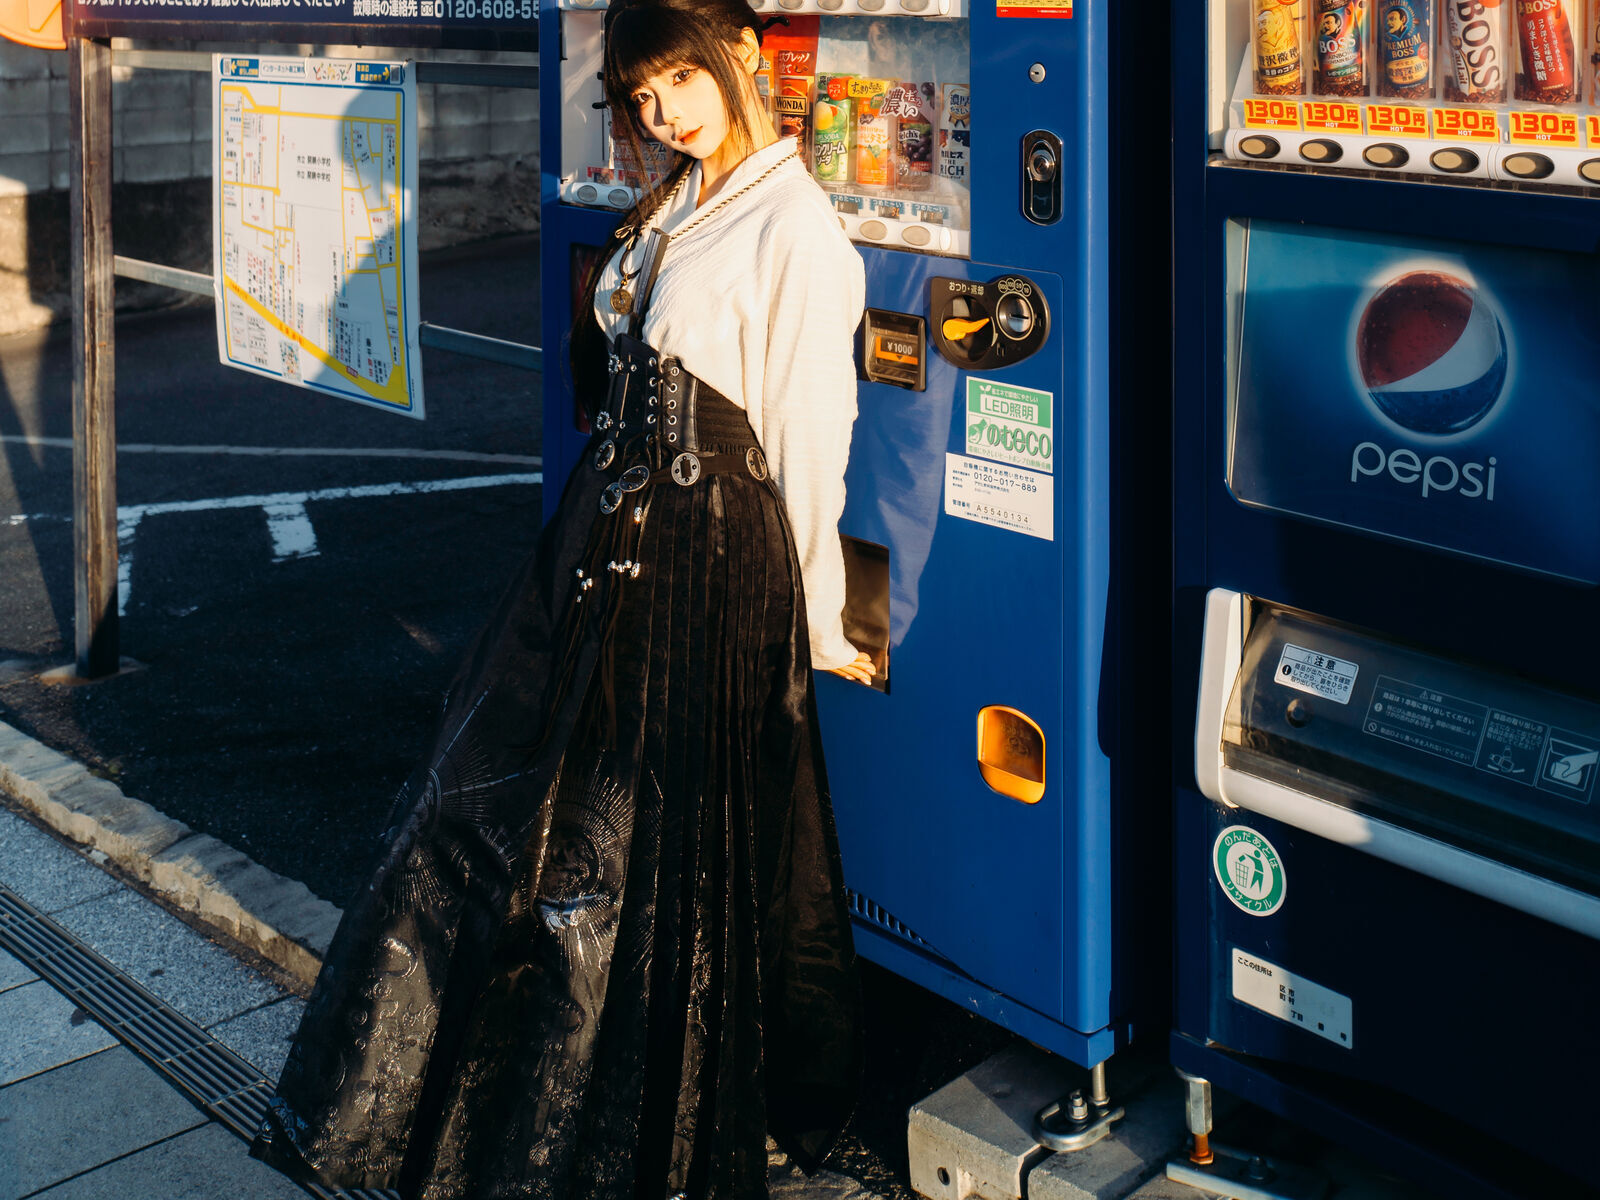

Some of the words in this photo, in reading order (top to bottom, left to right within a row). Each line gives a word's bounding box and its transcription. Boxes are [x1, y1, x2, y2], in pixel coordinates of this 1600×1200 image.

[353, 0, 418, 18] 故障時の連絡先
[434, 0, 540, 19] 0120-608-55
[1320, 33, 1356, 53] BOSS
[1391, 47, 1415, 59] BOSS
[1456, 0, 1500, 88] BOSS
[850, 81, 869, 95] すっきり
[776, 97, 804, 111] WONDA
[1246, 100, 1297, 119] 130円
[1304, 103, 1359, 122] 130円
[1368, 106, 1425, 126] 130円
[1434, 110, 1496, 130] 130円
[1511, 113, 1575, 134] 130円
[899, 129, 920, 140] elch's
[941, 165, 965, 177] RICH
[887, 341, 913, 355] ¥1000
[985, 397, 1034, 421] LED照明
[987, 423, 1052, 460] のむeco
[1351, 441, 1497, 501] pepsi
[974, 472, 1037, 493] 0120-017-889
[1314, 655, 1336, 671] 注意
[1293, 670, 1348, 692] してから、扉をひらき
[1295, 663, 1351, 686] 商品が出たことを確認
[1291, 676, 1338, 695] 取り出してください。
[1225, 831, 1278, 870] のんだあとは
[1226, 880, 1272, 911] リサイクル
[1237, 956, 1273, 977] ここの住所は
